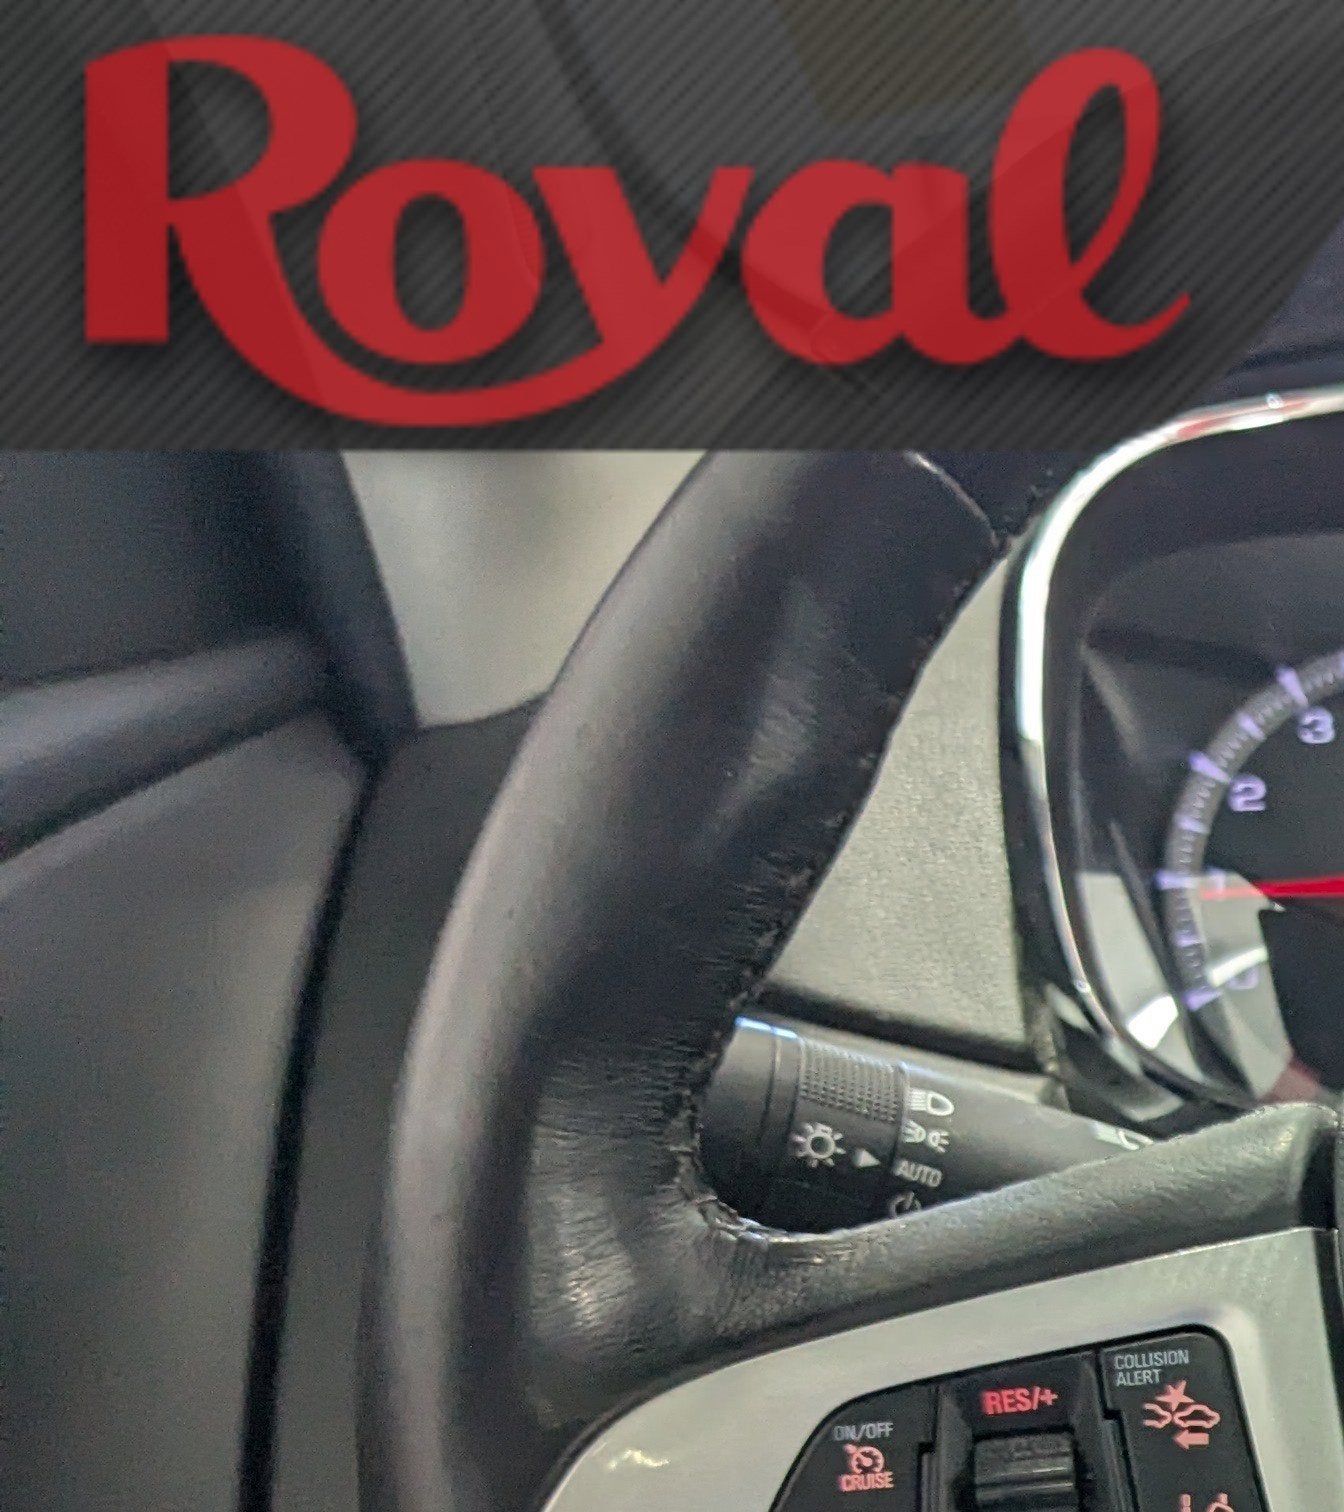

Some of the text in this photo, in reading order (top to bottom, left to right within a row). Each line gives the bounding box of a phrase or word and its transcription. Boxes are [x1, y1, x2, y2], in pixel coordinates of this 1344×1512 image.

[1300, 710, 1335, 746] 3
[1228, 775, 1267, 812] 2
[893, 1158, 943, 1188] AUTO
[1113, 1348, 1190, 1373] COLLISION
[1114, 1366, 1162, 1388] ALERT
[981, 1387, 1059, 1416] RES/+
[832, 1420, 895, 1443] ON/OFF
[839, 1471, 895, 1493] CRUISE
